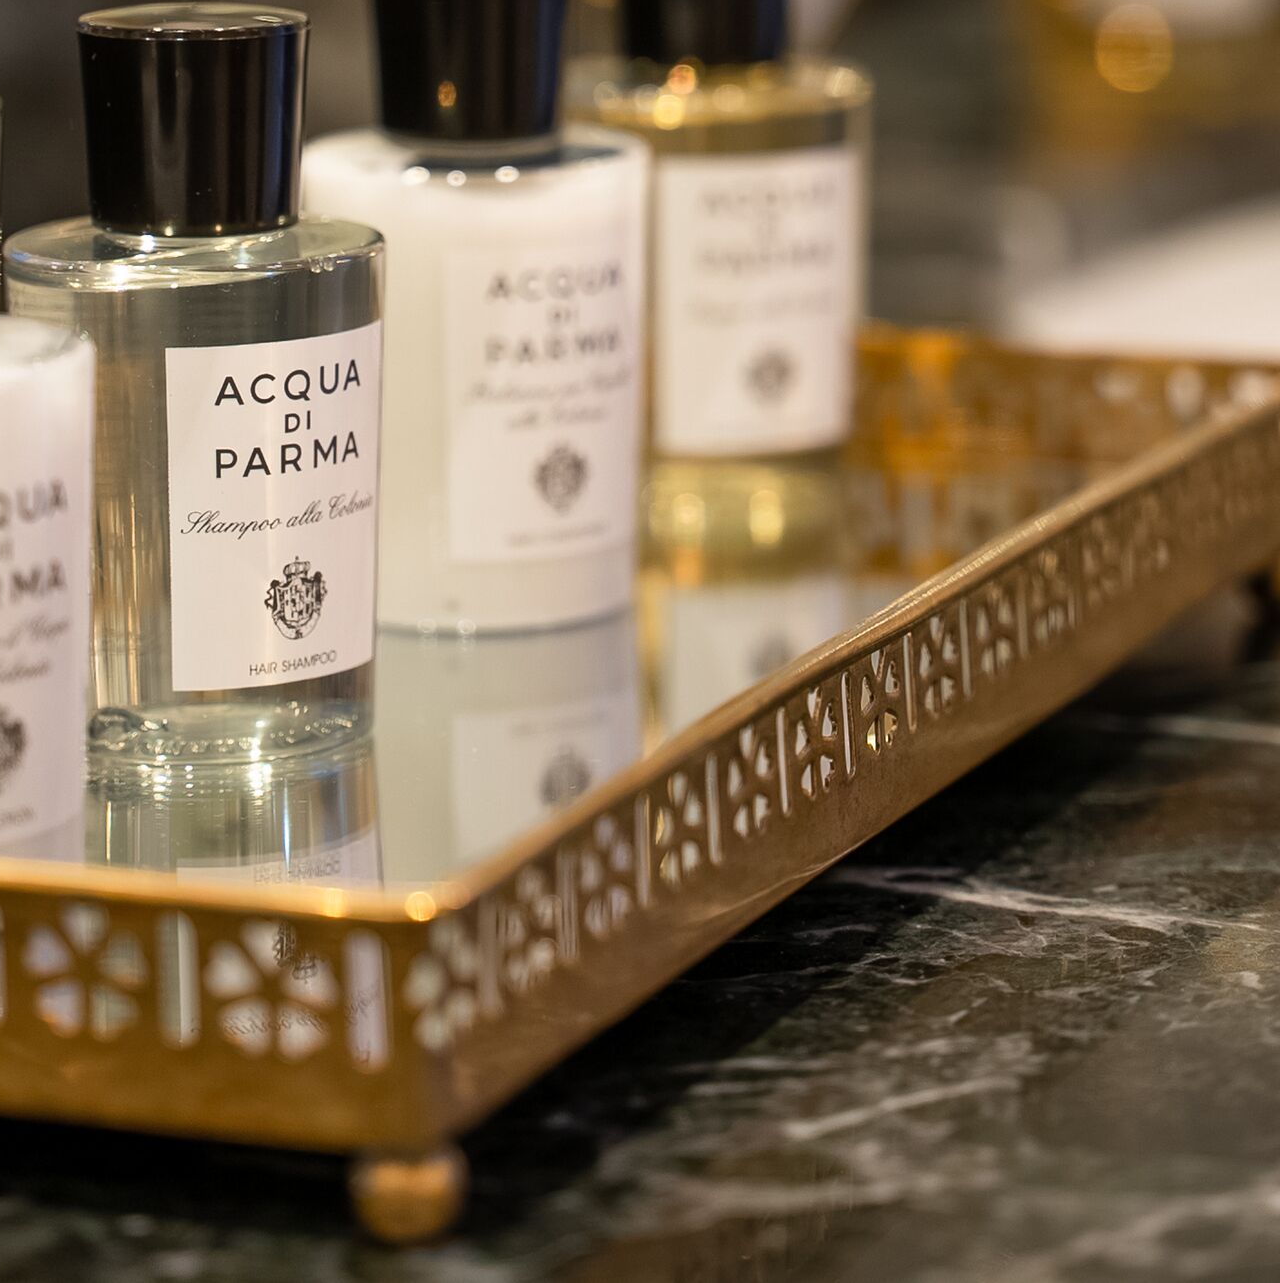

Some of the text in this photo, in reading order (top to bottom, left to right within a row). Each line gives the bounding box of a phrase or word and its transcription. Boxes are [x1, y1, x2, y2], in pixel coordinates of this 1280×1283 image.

[214, 359, 361, 406] ACQUA
[284, 410, 311, 433] DI
[215, 431, 359, 478] PARMA
[180, 510, 282, 540] Shampoo
[286, 500, 323, 528] alla
[249, 650, 338, 676] HAIR SHAMPOO
